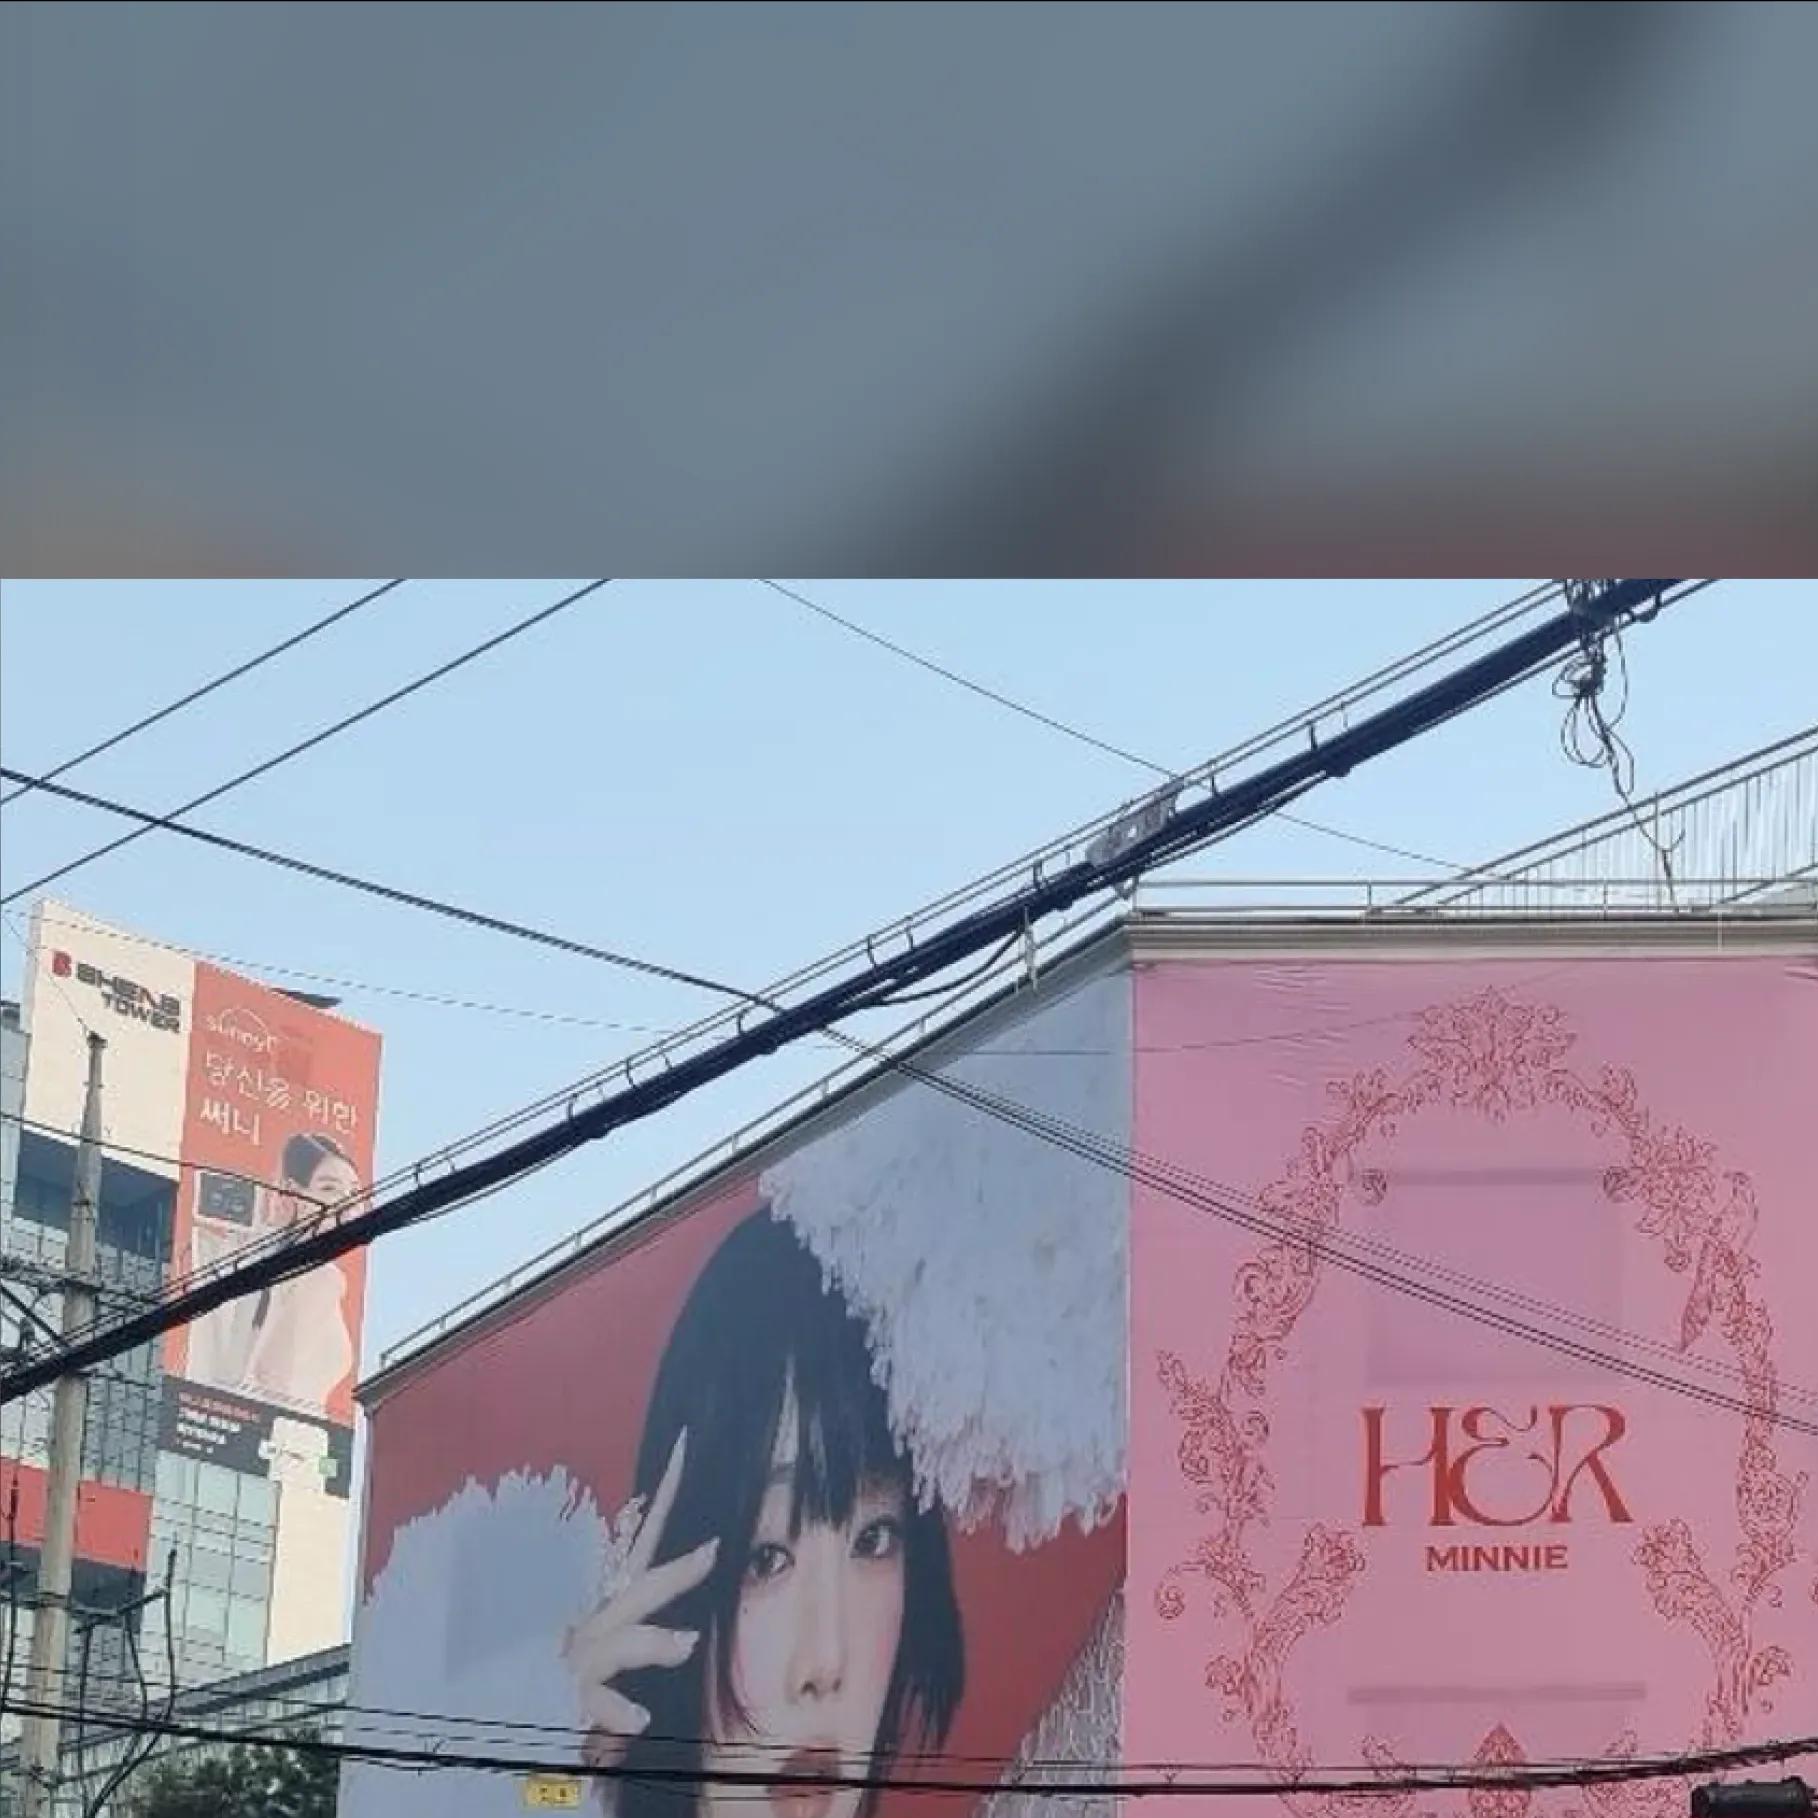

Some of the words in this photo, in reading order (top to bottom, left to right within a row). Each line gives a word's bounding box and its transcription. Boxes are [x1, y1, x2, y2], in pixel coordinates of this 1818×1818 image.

[101, 991, 180, 1034] TOWER
[206, 1050, 291, 1109] 당신을
[303, 1090, 357, 1135] 위한
[200, 1097, 261, 1146] 써니
[1360, 1403, 1634, 1527] HER
[1425, 1546, 1569, 1572] MINNIE
